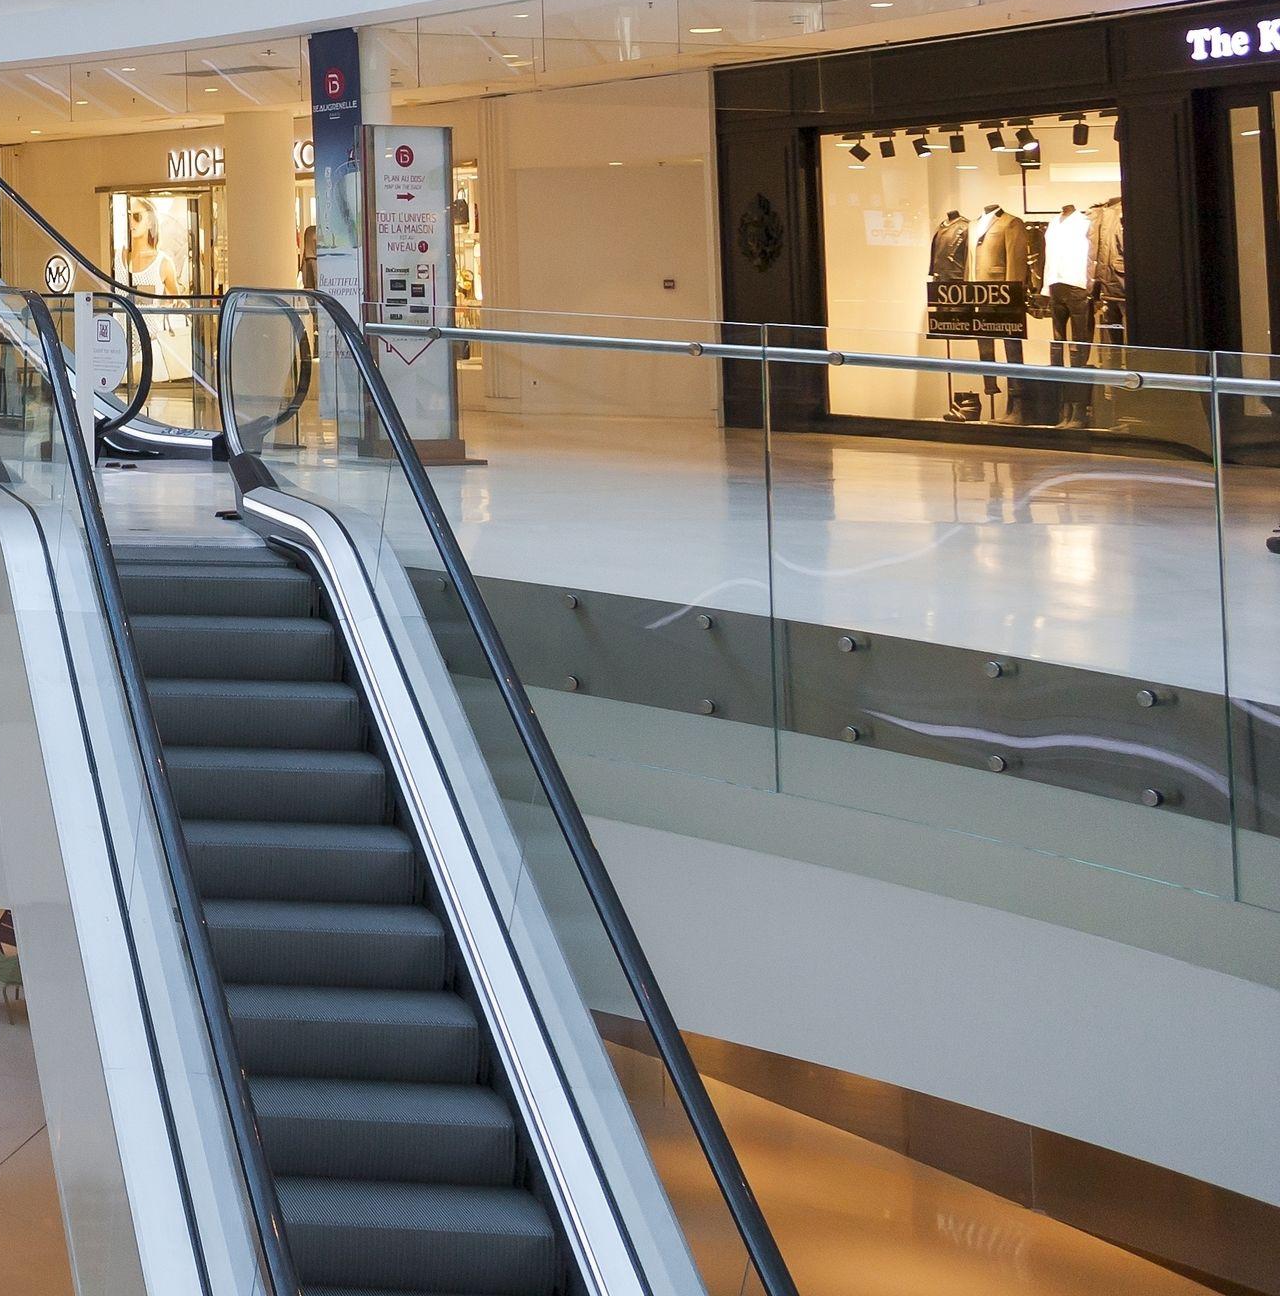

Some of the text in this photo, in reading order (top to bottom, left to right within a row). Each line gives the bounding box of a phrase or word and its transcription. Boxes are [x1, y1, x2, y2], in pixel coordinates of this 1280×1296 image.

[1185, 26, 1250, 61] The
[313, 100, 358, 113] BEAUGRENELLE
[167, 148, 226, 179] MICH
[383, 174, 400, 183] PLAN
[401, 175, 409, 183] AU
[376, 211, 437, 223] TOUT L'UNIVERS
[378, 224, 434, 234] DE LA MAISON
[387, 241, 417, 252] NIVEAU
[937, 284, 1011, 305] SOLDES
[929, 318, 1023, 336] Dernière Démarque
